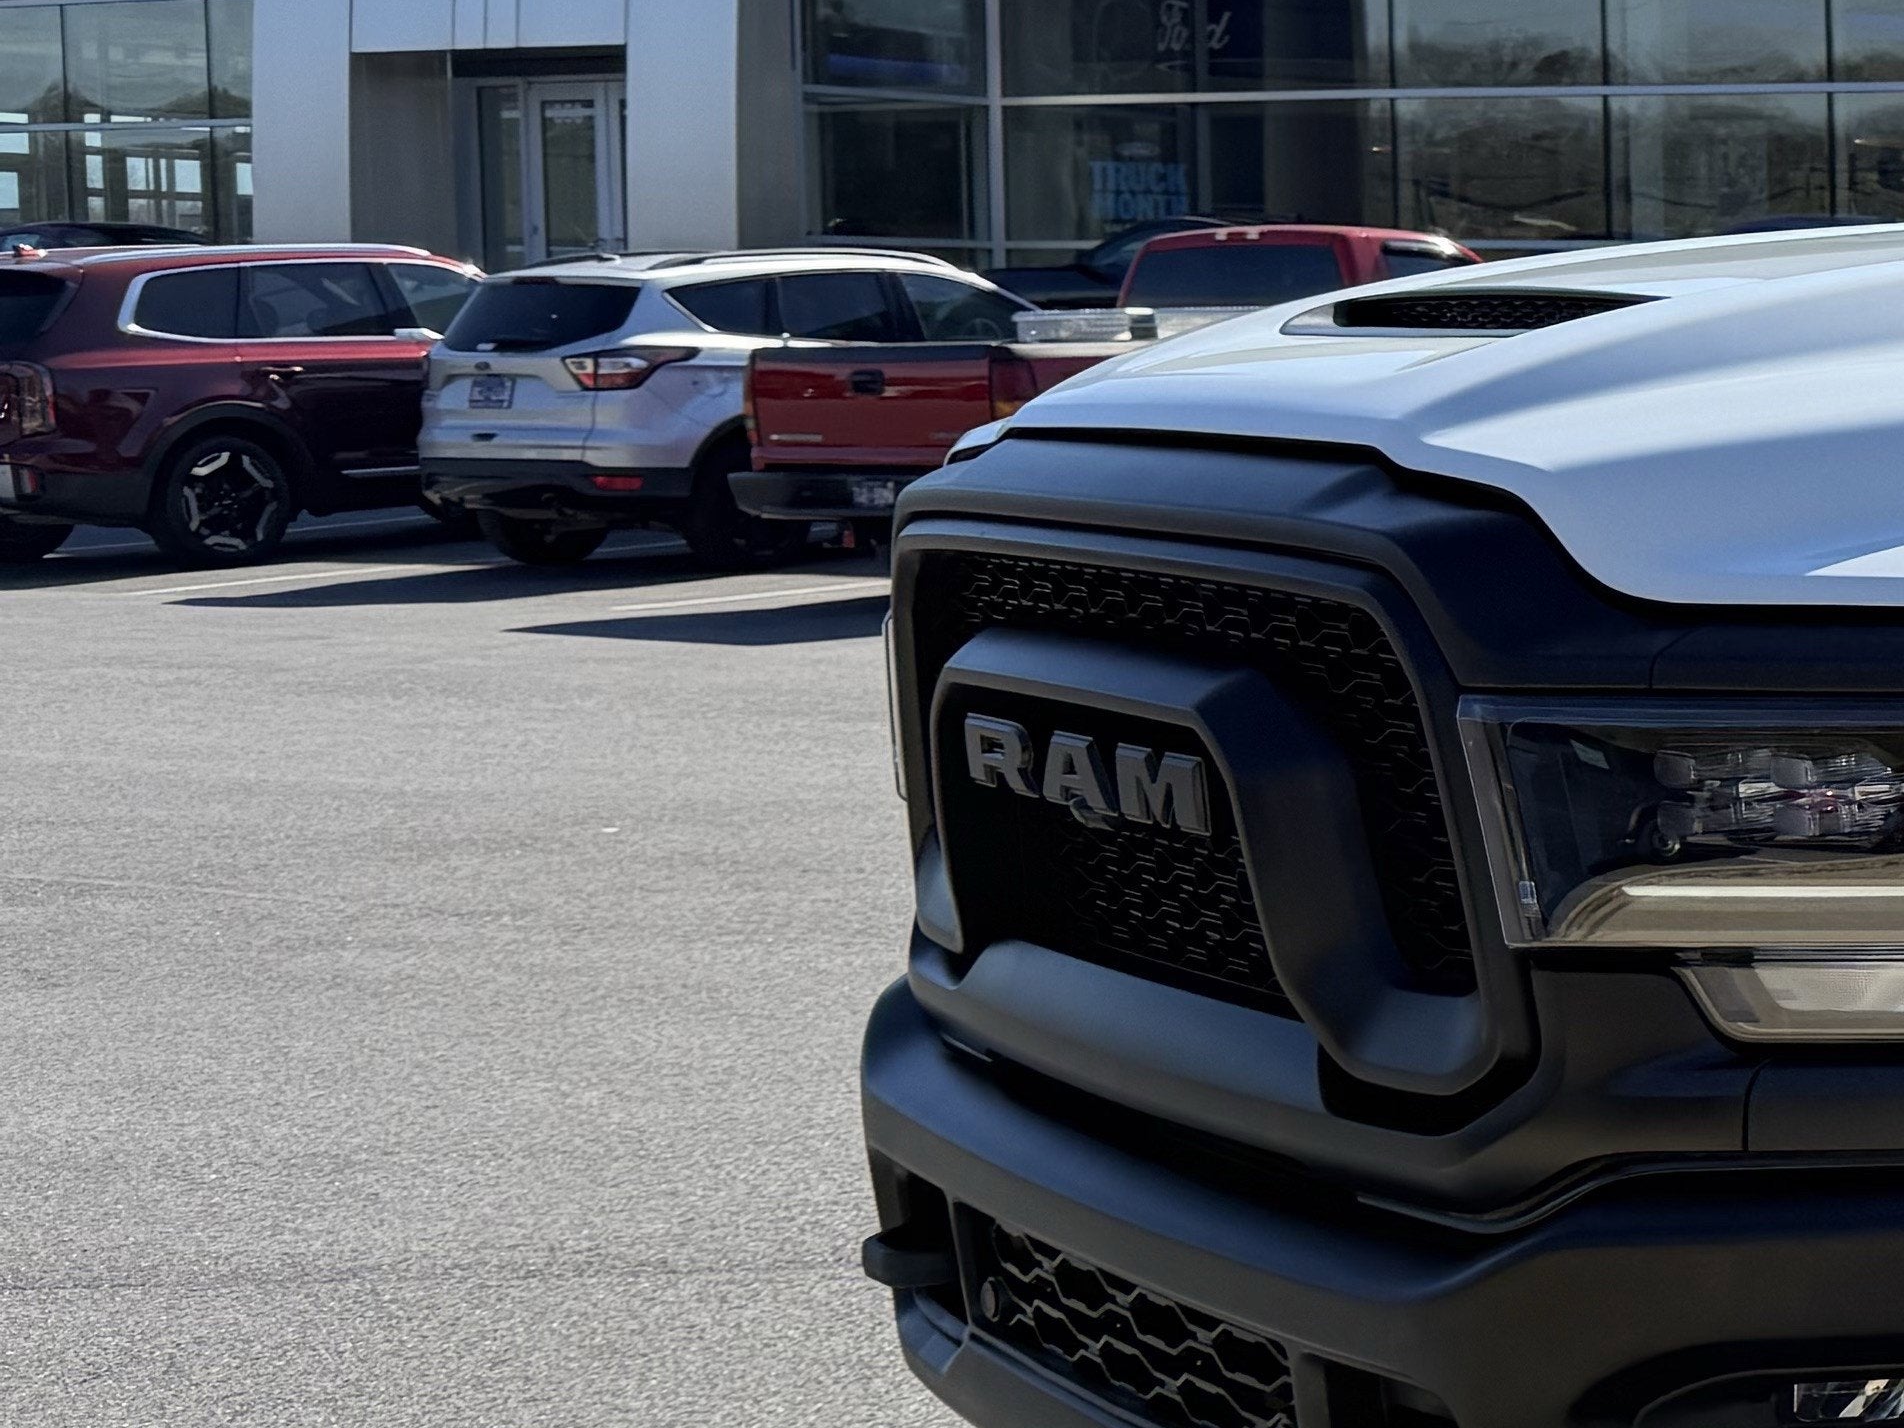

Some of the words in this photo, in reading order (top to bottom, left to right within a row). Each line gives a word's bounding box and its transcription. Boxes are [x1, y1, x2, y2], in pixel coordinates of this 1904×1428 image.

[1157, 0, 1232, 51] Fod
[1090, 160, 1186, 191] TRUCK
[964, 713, 1212, 836] RAM
